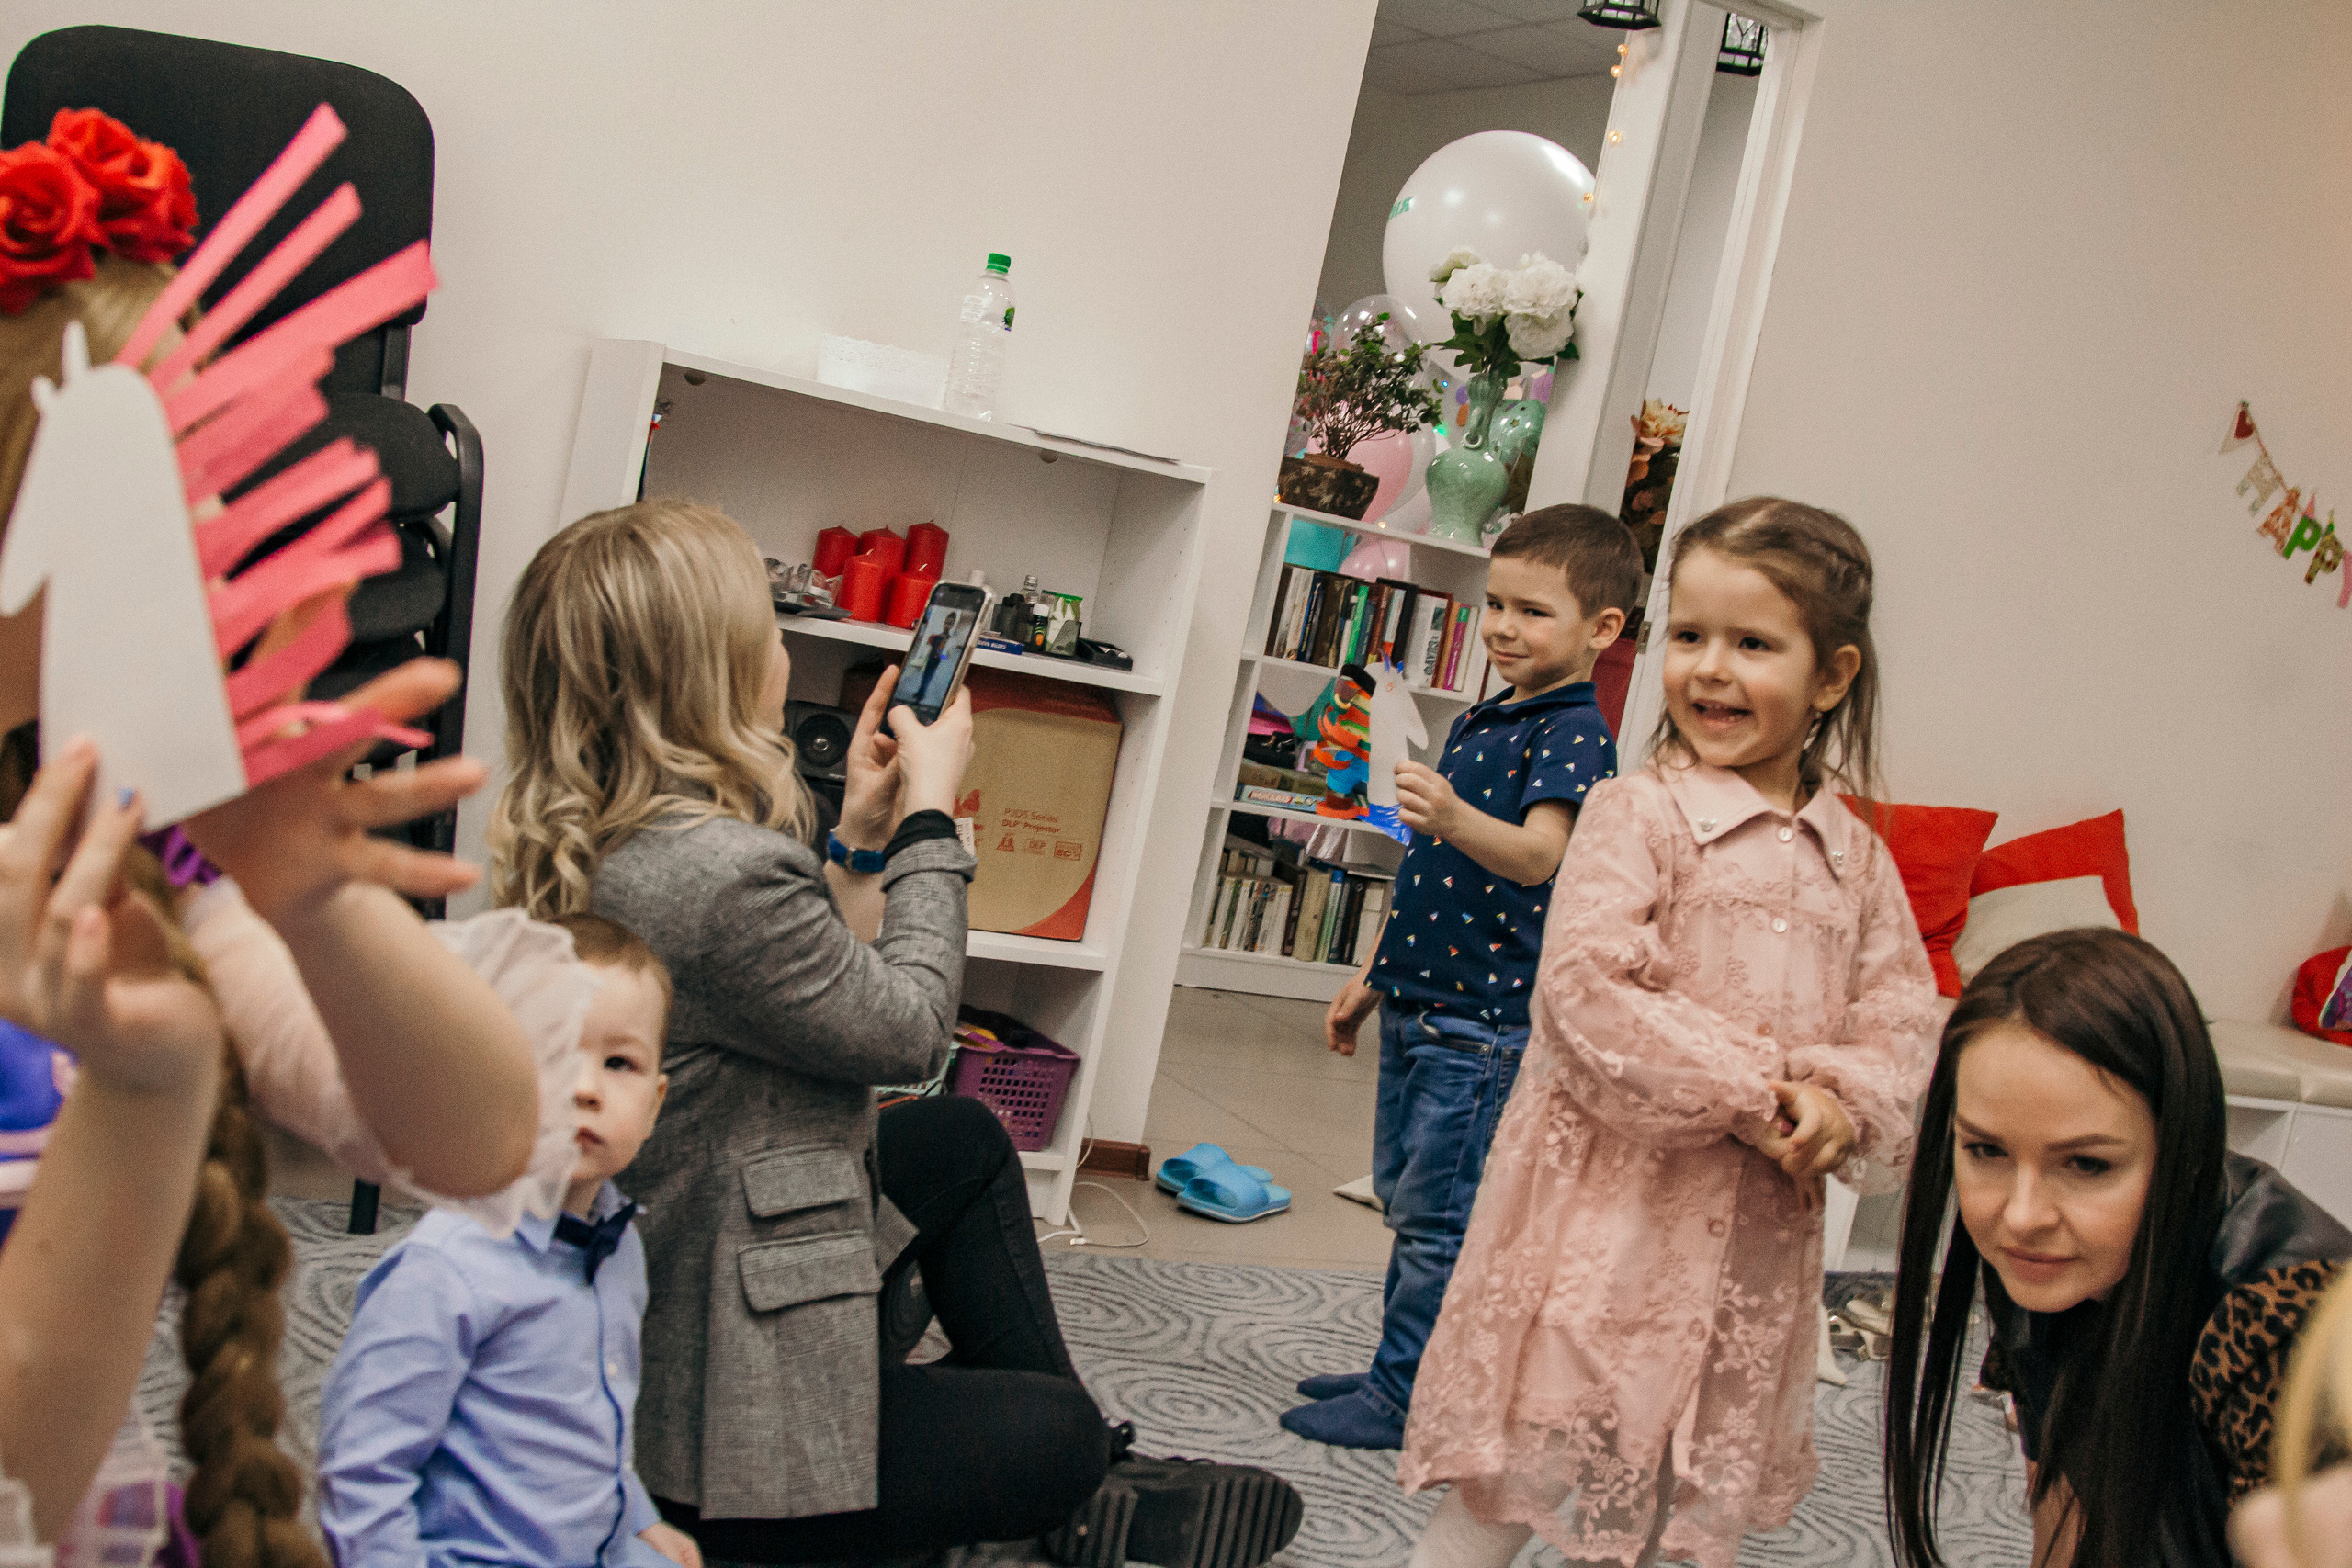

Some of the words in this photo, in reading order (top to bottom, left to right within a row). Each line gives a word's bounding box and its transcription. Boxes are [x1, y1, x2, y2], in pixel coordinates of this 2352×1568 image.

[1031, 812, 1058, 823] Series
[1001, 819, 1021, 828] DLP
[1023, 821, 1060, 833] Projector
